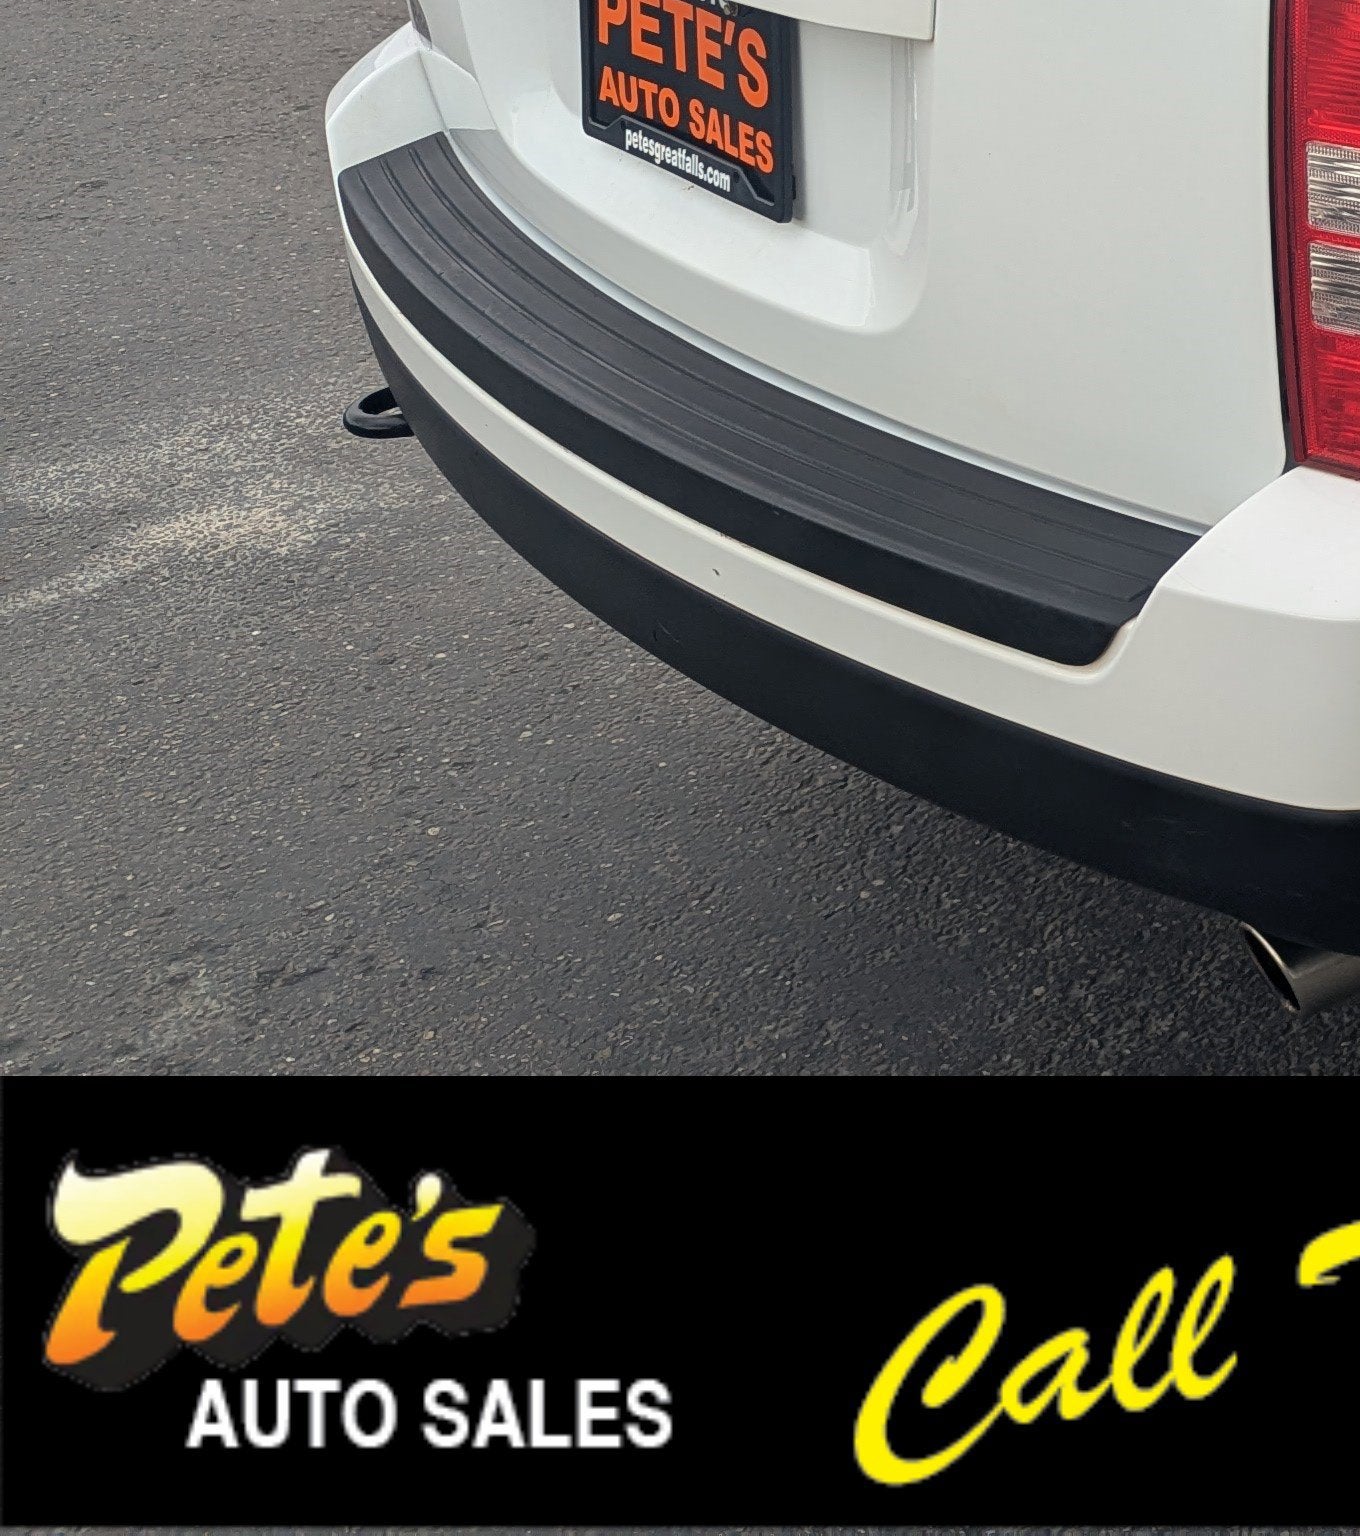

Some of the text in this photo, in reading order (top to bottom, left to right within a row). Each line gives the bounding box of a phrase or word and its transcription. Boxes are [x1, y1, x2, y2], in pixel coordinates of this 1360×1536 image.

[598, 65, 774, 174] AUTO SALES
[625, 128, 731, 192] petesgreatfalls.com
